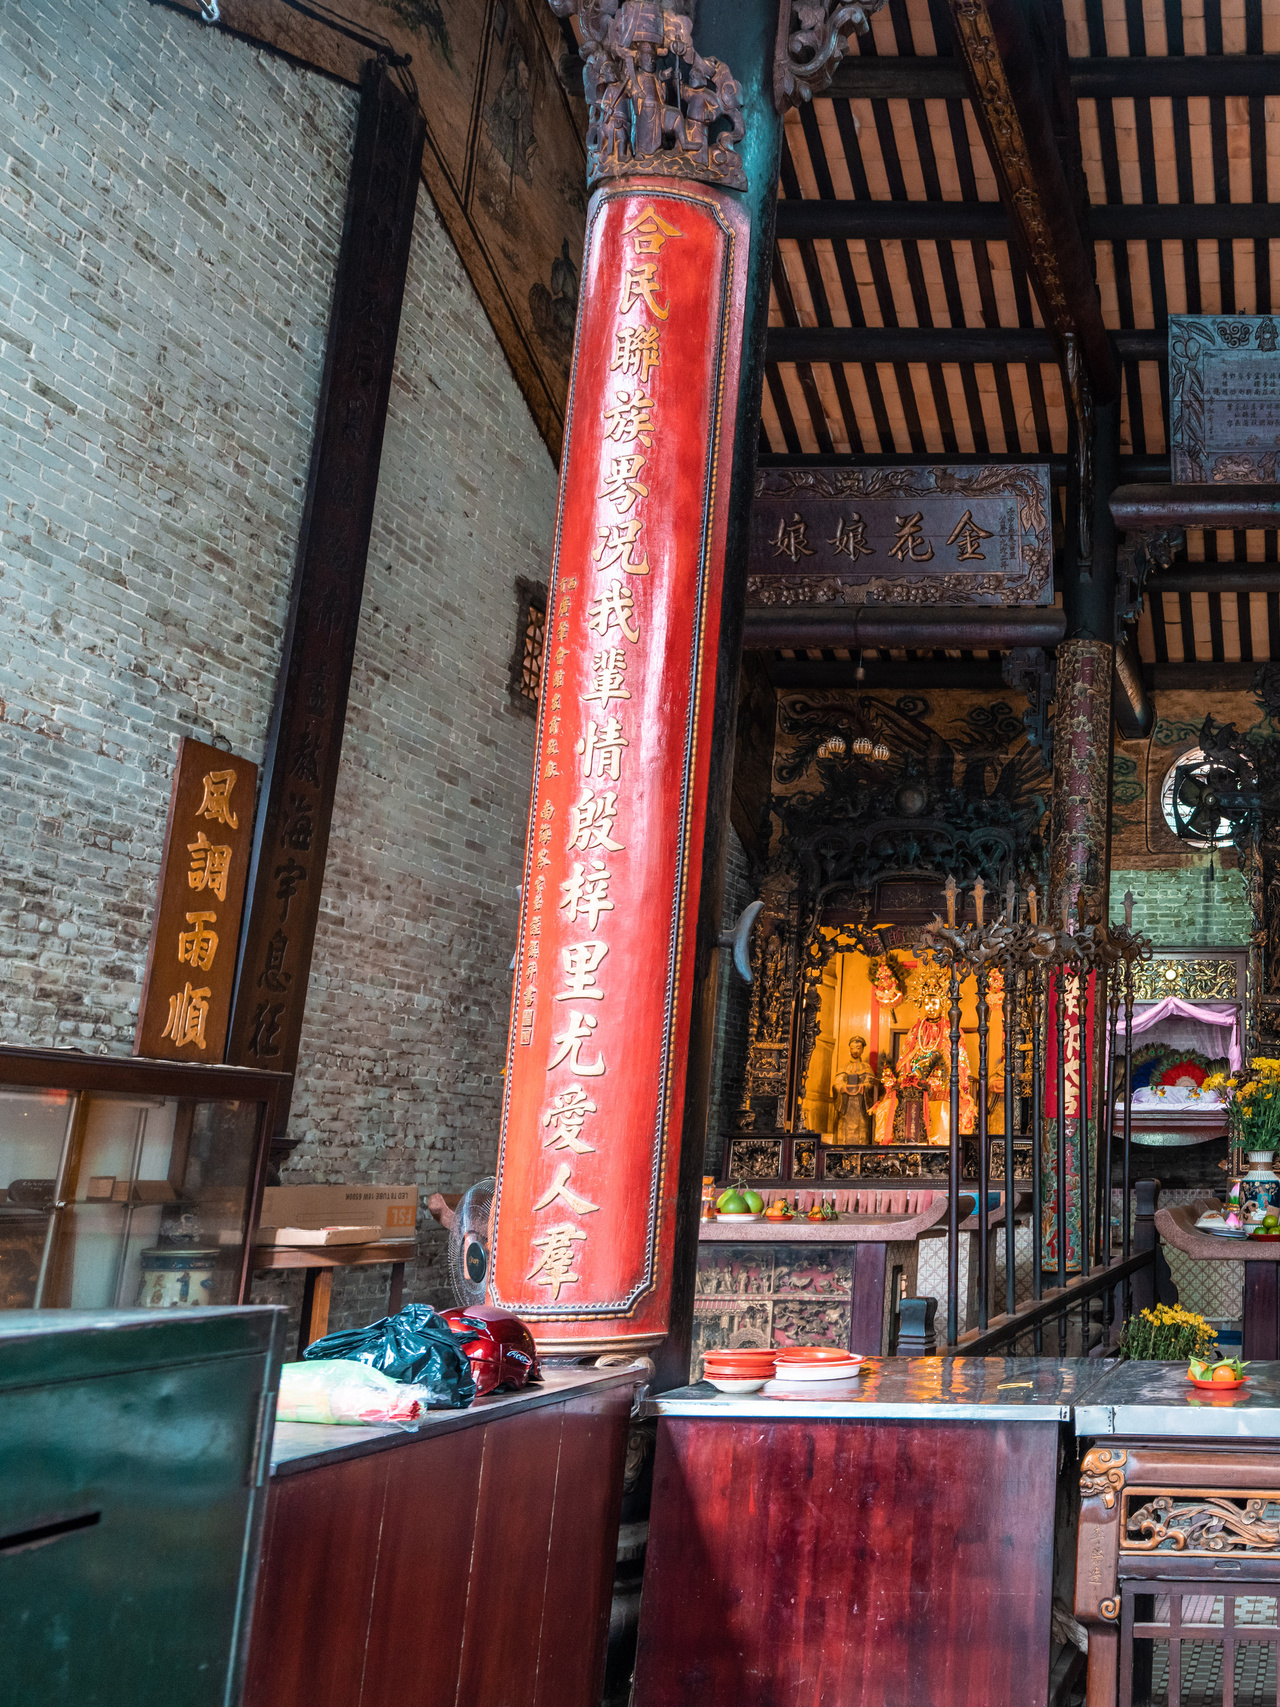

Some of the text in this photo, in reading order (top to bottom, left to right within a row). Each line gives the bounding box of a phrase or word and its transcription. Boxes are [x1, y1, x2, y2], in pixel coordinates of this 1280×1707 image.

[768, 508, 995, 564] 金花娘娘
[161, 768, 239, 1052] 風調雨順
[376, 1192, 390, 1201] TUBE
[397, 1192, 408, 1200] LED
[392, 1208, 412, 1225] FSL
